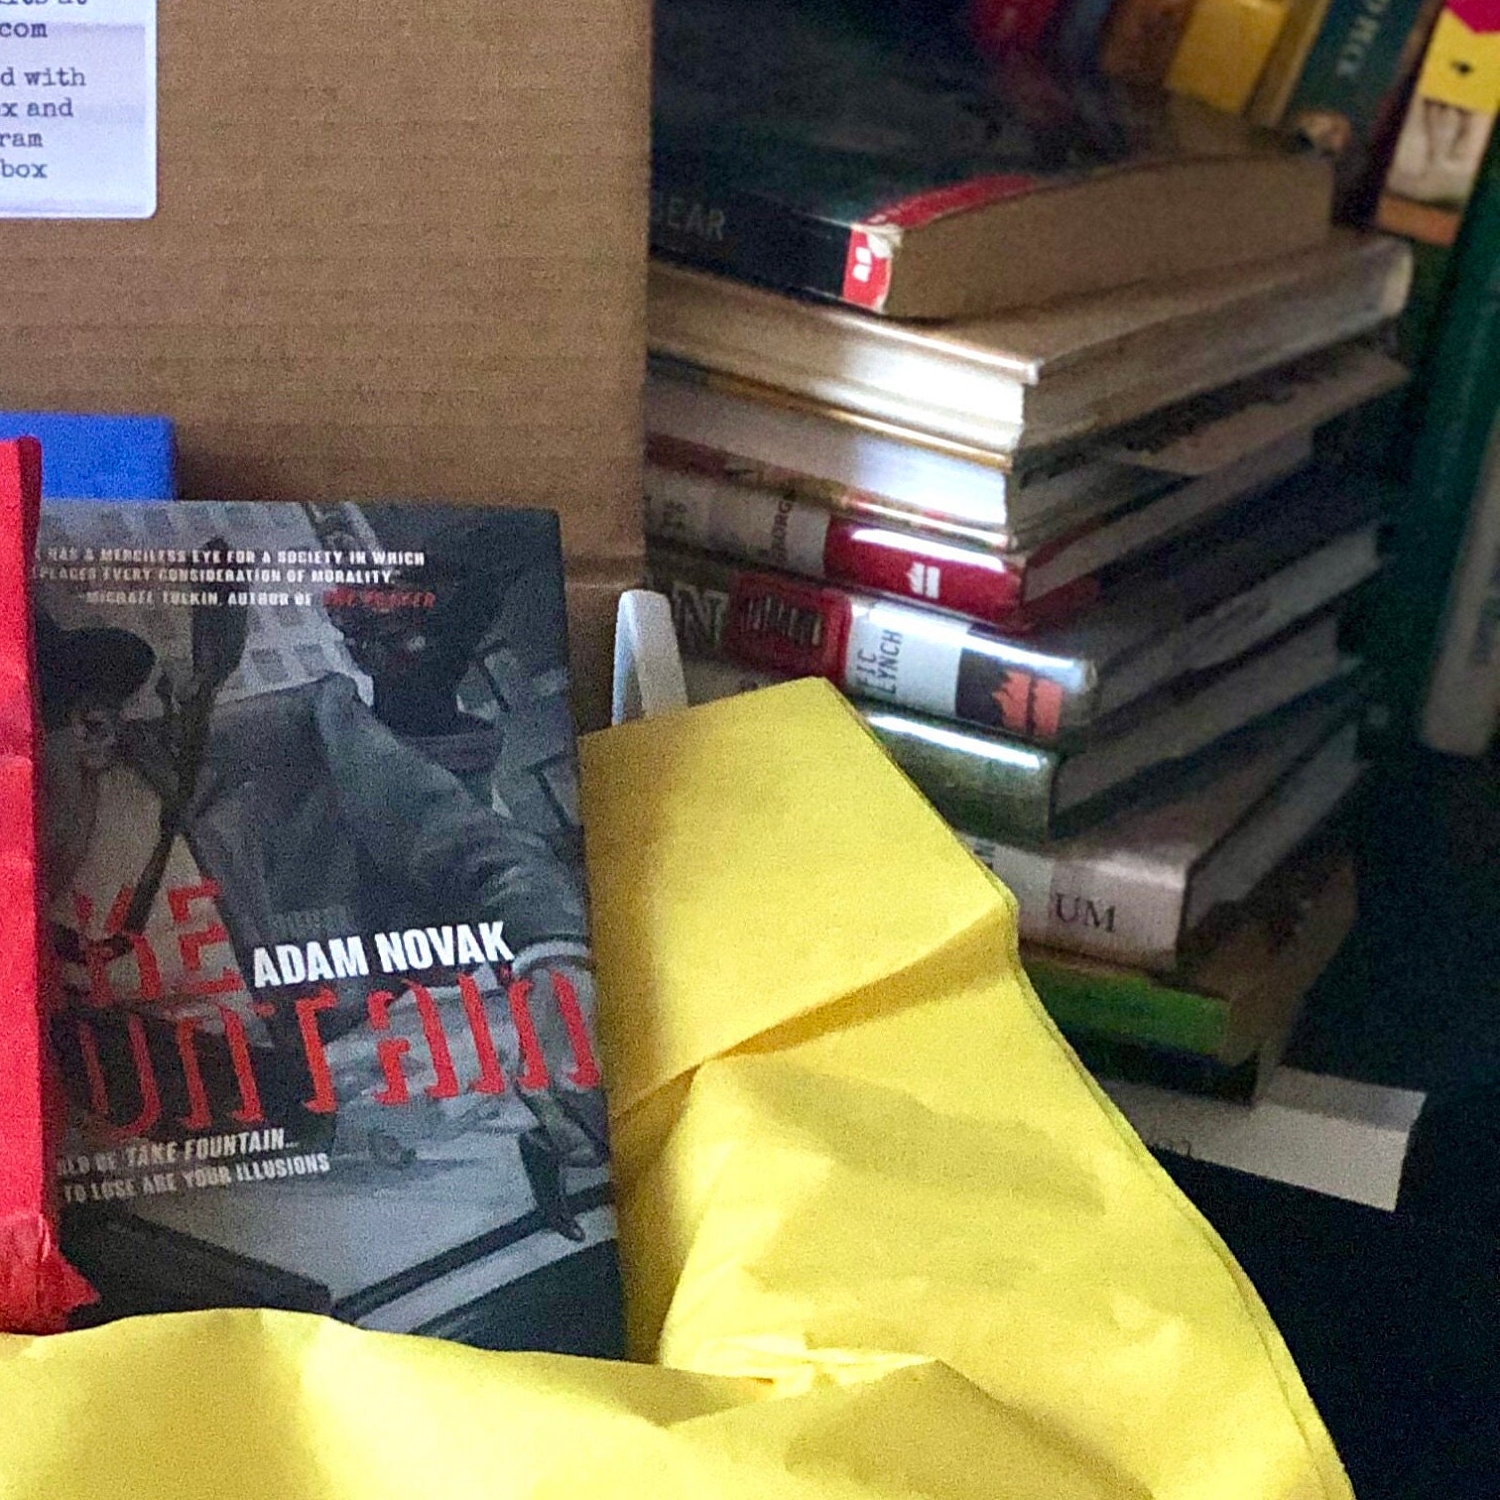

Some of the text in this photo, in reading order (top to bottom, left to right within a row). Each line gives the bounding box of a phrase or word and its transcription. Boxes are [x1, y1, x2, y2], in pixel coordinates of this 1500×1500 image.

[25, 65, 87, 87] with
[26, 97, 74, 118] and
[100, 548, 187, 564] MERCILESS
[192, 548, 221, 564] EYE
[226, 550, 255, 564] FOR
[262, 550, 272, 564] A
[277, 550, 343, 565] SOCIETY
[350, 551, 367, 565] IN
[372, 551, 426, 566] WHICH
[32, 566, 97, 582] PLACES
[102, 567, 151, 582] EVERY
[158, 567, 282, 583] CONSIDERATION
[286, 569, 305, 583] OF
[227, 592, 289, 606] AUTHOR
[295, 592, 313, 606] OF
[857, 649, 878, 690] FIC
[877, 629, 903, 695] LYNCH
[253, 936, 369, 989] ADAM
[374, 920, 515, 974] NOVAK
[92, 1179, 137, 1201] LOSE
[143, 1172, 178, 1195] ARE
[184, 1164, 232, 1189] YOUR
[236, 1152, 331, 1182] ILLUSIONS
